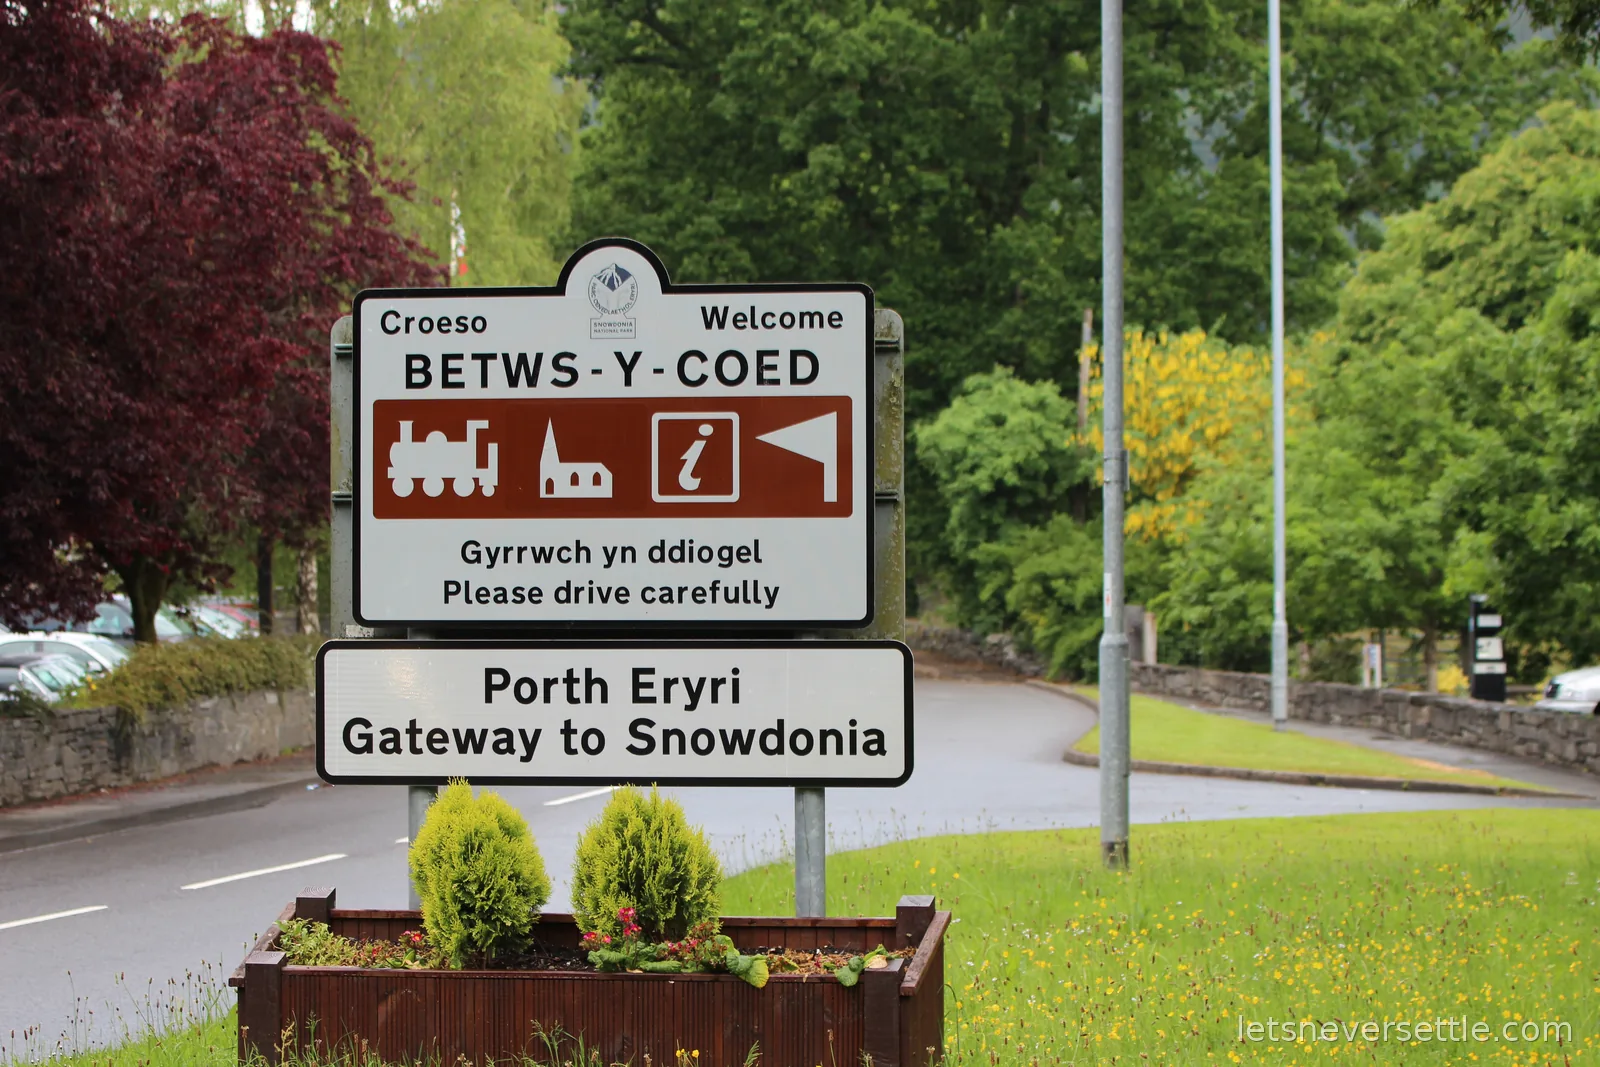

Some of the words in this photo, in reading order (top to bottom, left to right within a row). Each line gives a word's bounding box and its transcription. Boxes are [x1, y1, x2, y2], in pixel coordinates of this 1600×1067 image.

[380, 309, 488, 336] Croeso
[700, 305, 844, 331] Welcome
[460, 539, 592, 570] Gyrrwch
[601, 545, 637, 570] yn
[647, 538, 763, 569] ddiogel
[444, 581, 543, 604] Please
[554, 580, 630, 604] drive
[641, 580, 779, 609] carefully
[484, 667, 609, 705] Porth
[631, 666, 740, 712] Eryri
[342, 717, 543, 763] Gateway
[559, 718, 606, 756] to
[625, 717, 888, 757] Snowdonia
